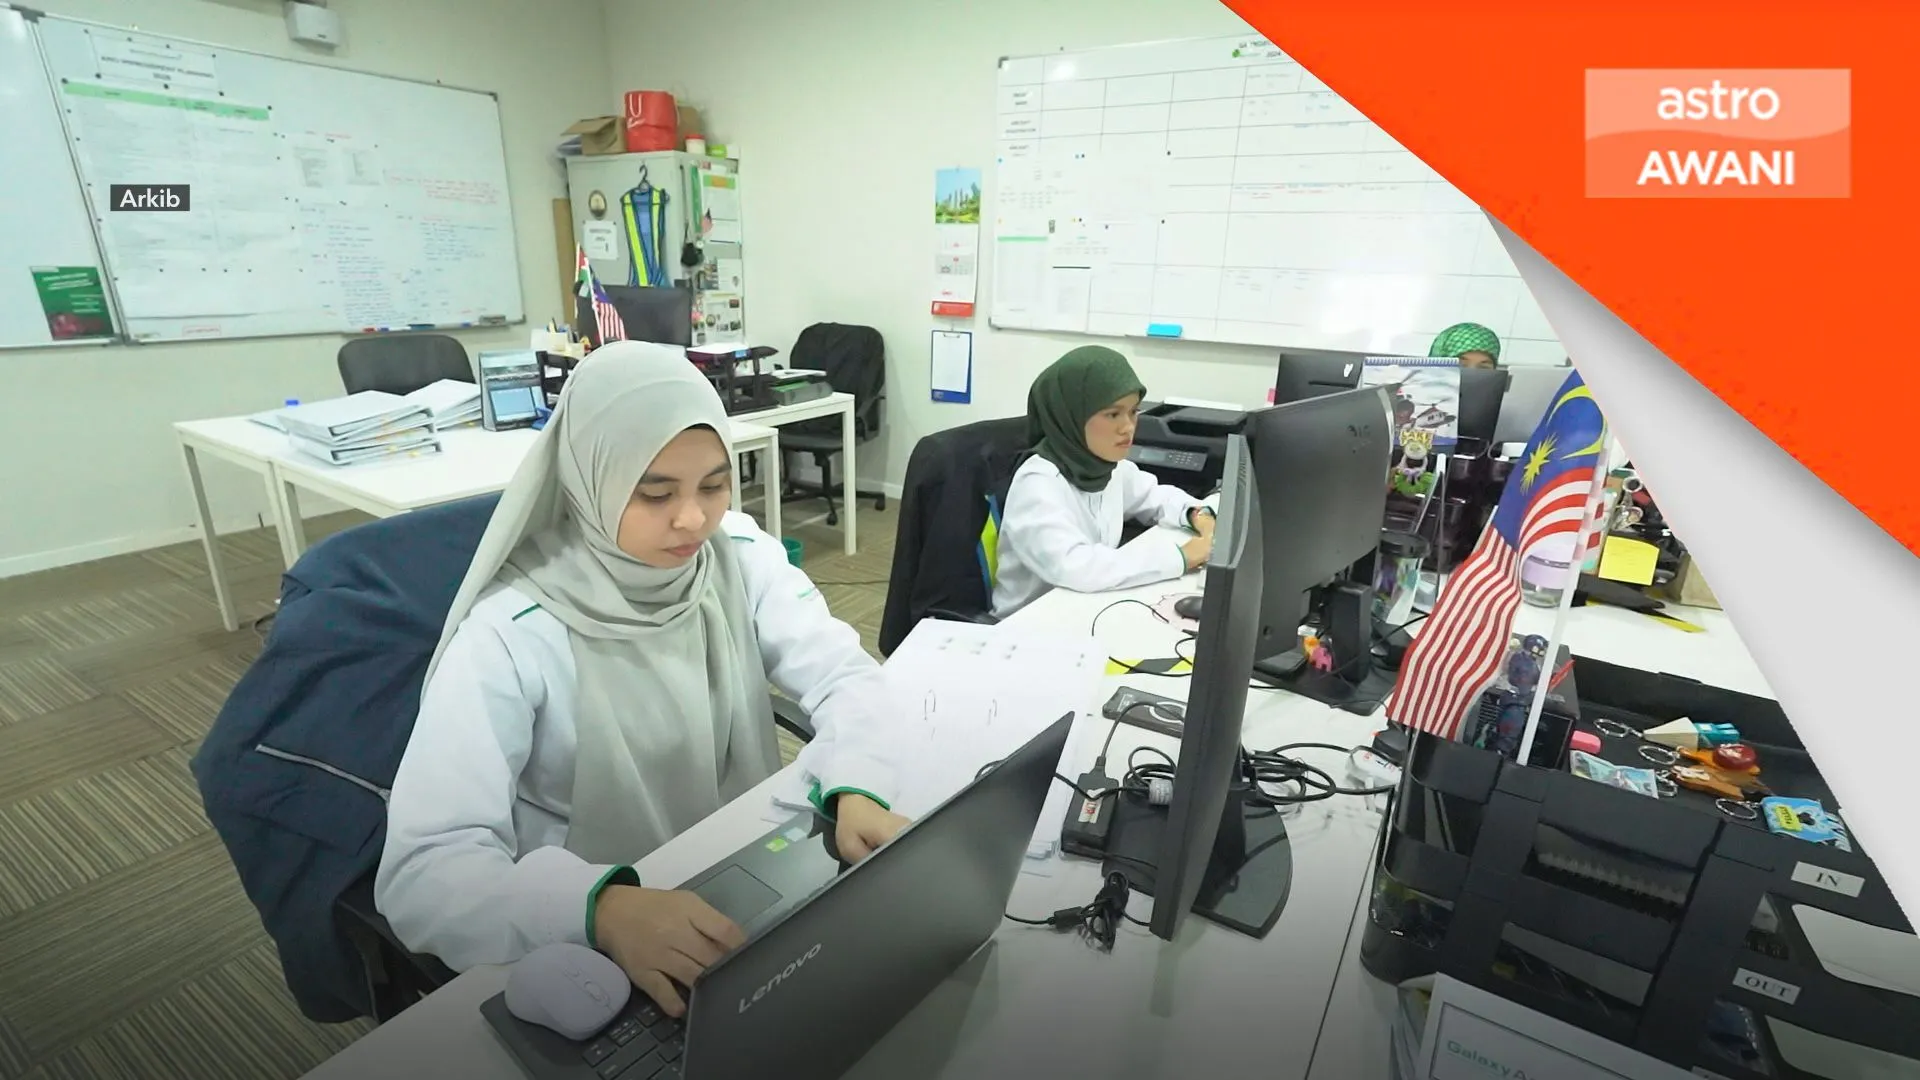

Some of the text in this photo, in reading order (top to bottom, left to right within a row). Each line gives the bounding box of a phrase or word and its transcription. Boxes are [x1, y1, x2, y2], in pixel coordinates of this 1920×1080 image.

[1815, 872, 1842, 887] IN
[738, 942, 822, 1014] Lenovo
[1745, 976, 1792, 997] OUT
